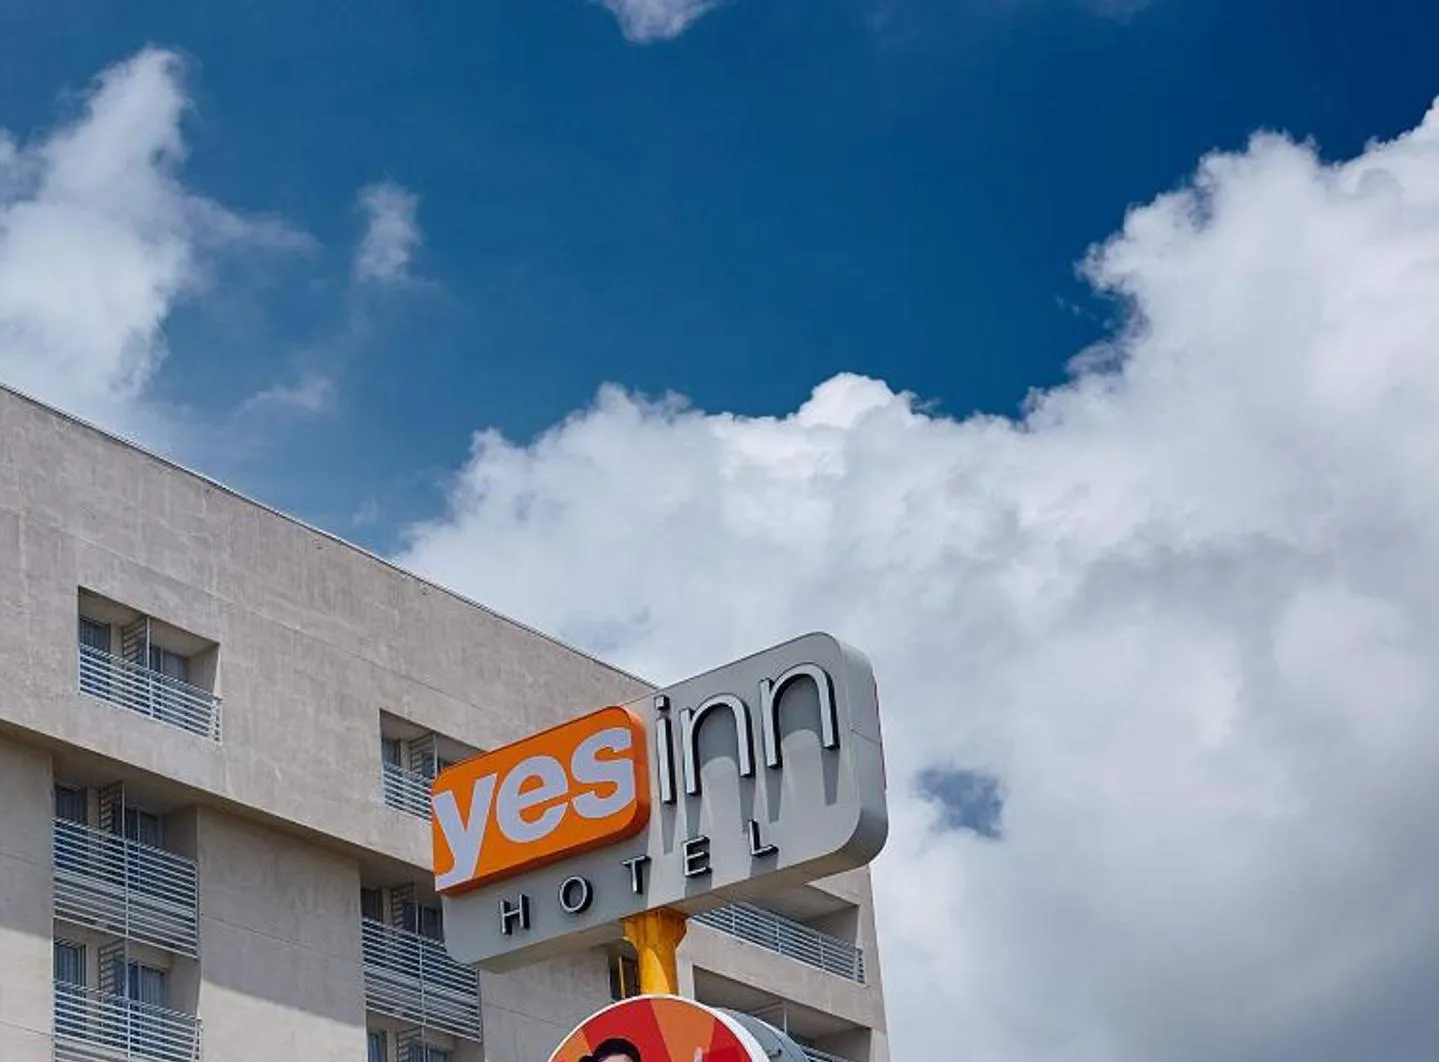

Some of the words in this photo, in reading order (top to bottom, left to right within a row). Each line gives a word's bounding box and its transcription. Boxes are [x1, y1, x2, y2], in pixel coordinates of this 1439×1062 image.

[433, 727, 636, 891] yes
[654, 663, 840, 804] inn
[500, 820, 779, 935] HOTEL
